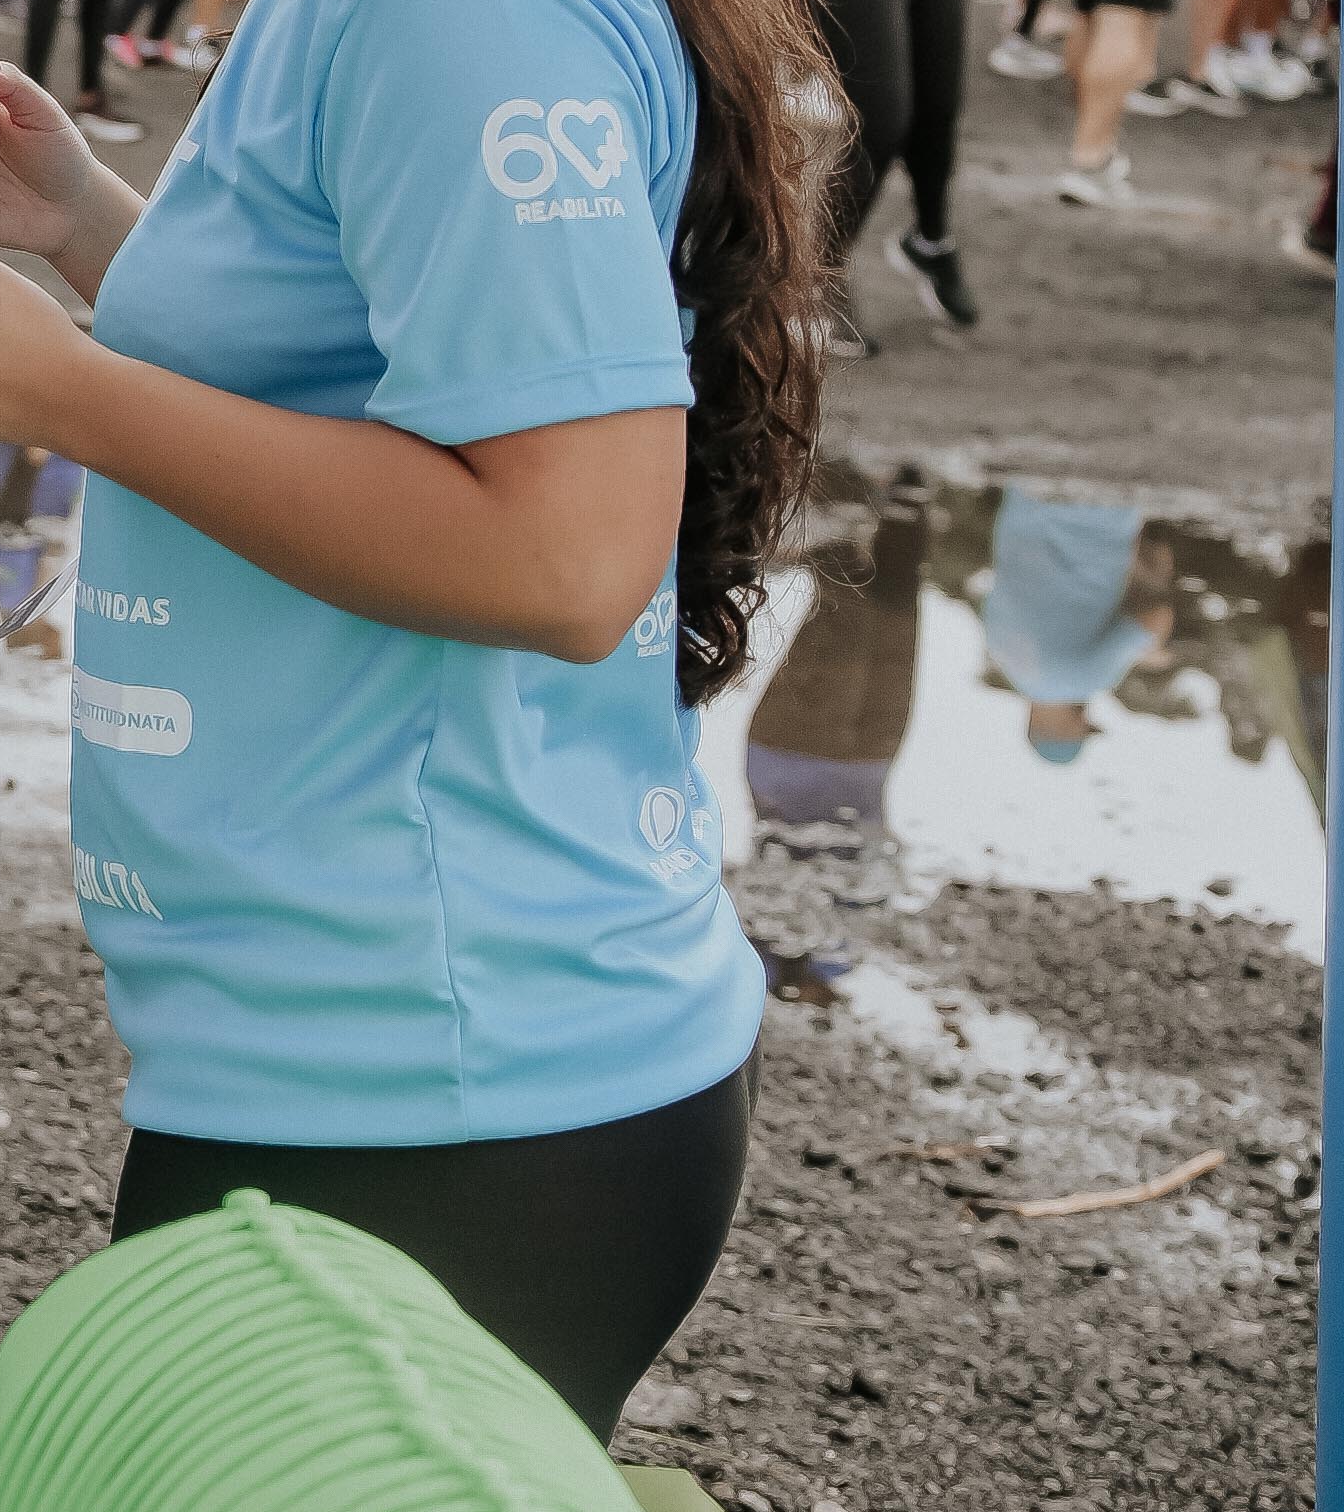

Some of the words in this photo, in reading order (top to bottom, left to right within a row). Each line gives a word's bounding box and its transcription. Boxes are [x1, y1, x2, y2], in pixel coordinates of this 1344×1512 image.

[515, 196, 626, 226] REABILITA
[97, 587, 172, 626] VIDAS
[75, 846, 164, 921] BILITA
